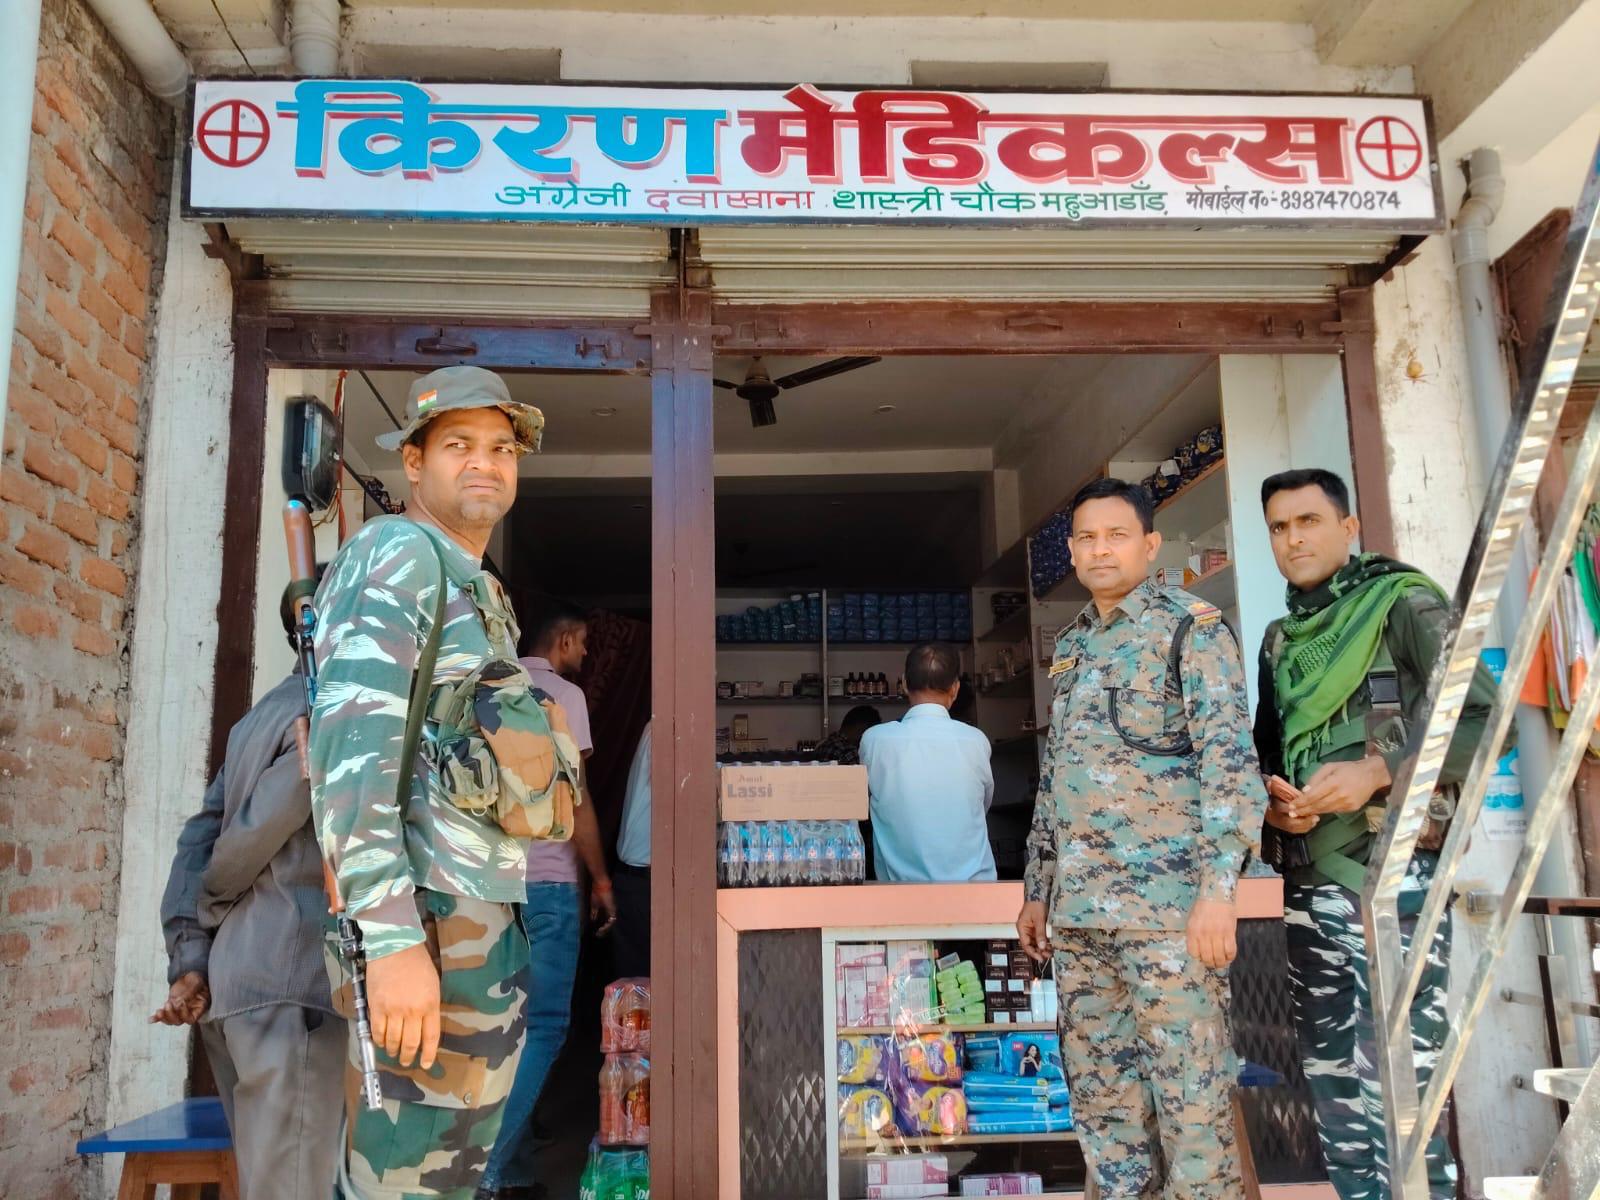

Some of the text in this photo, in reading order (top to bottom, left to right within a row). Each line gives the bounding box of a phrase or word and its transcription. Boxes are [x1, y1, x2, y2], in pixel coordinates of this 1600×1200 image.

[276, 79, 1352, 186] किरण मेडिकल्स
[644, 188, 816, 212] दवाखाना
[832, 186, 944, 213] शास्त्री
[951, 181, 1035, 213] चौक
[727, 783, 772, 798] Lassi
